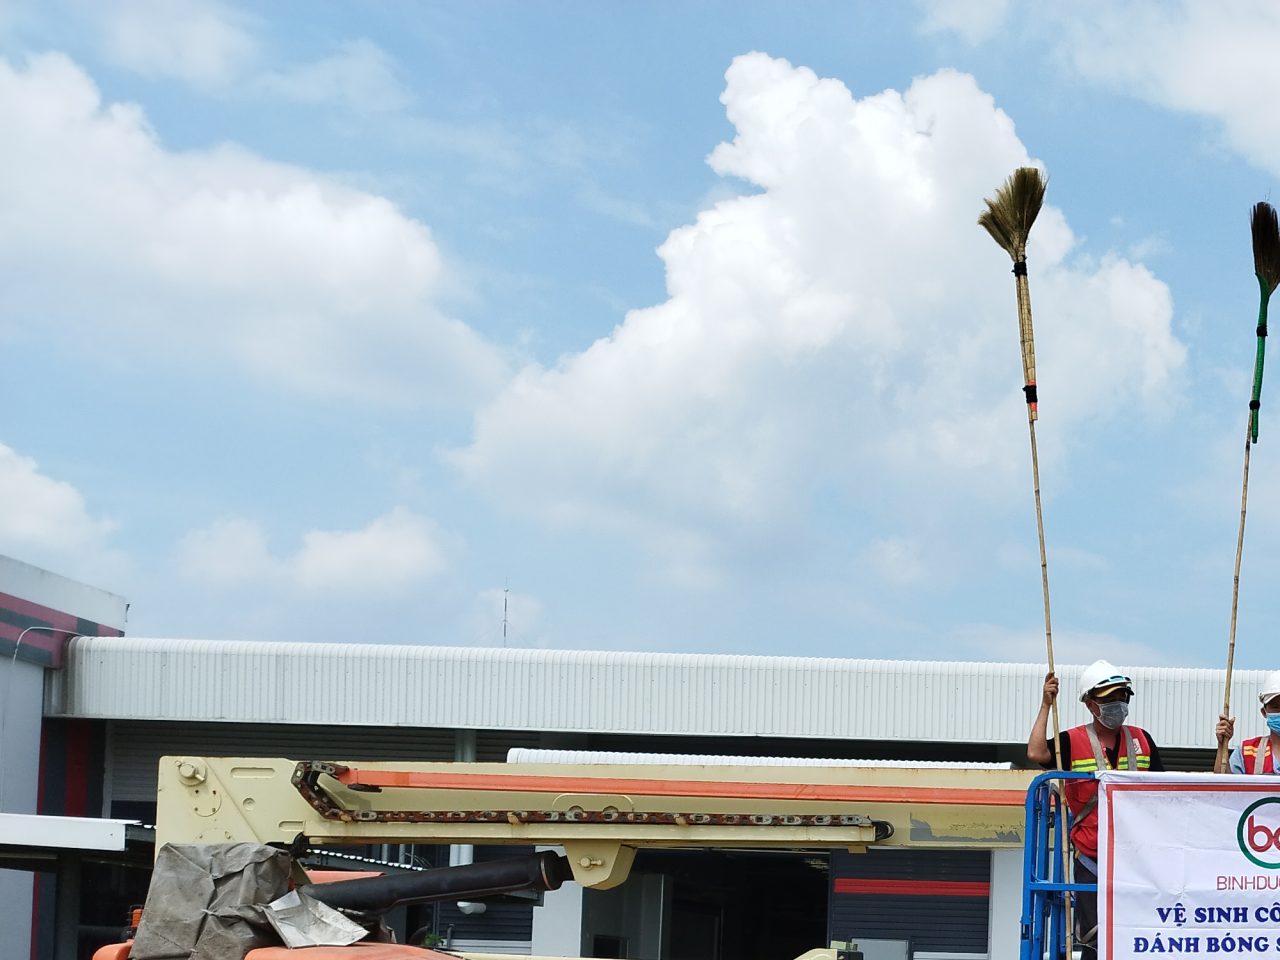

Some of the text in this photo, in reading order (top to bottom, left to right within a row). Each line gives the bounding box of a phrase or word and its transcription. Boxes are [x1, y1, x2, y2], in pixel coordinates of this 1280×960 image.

[1156, 902, 1187, 927] VỆ
[1194, 907, 1249, 923] SINH
[1133, 932, 1200, 953] ĐÁNH
[1206, 932, 1270, 953] BÓNG
